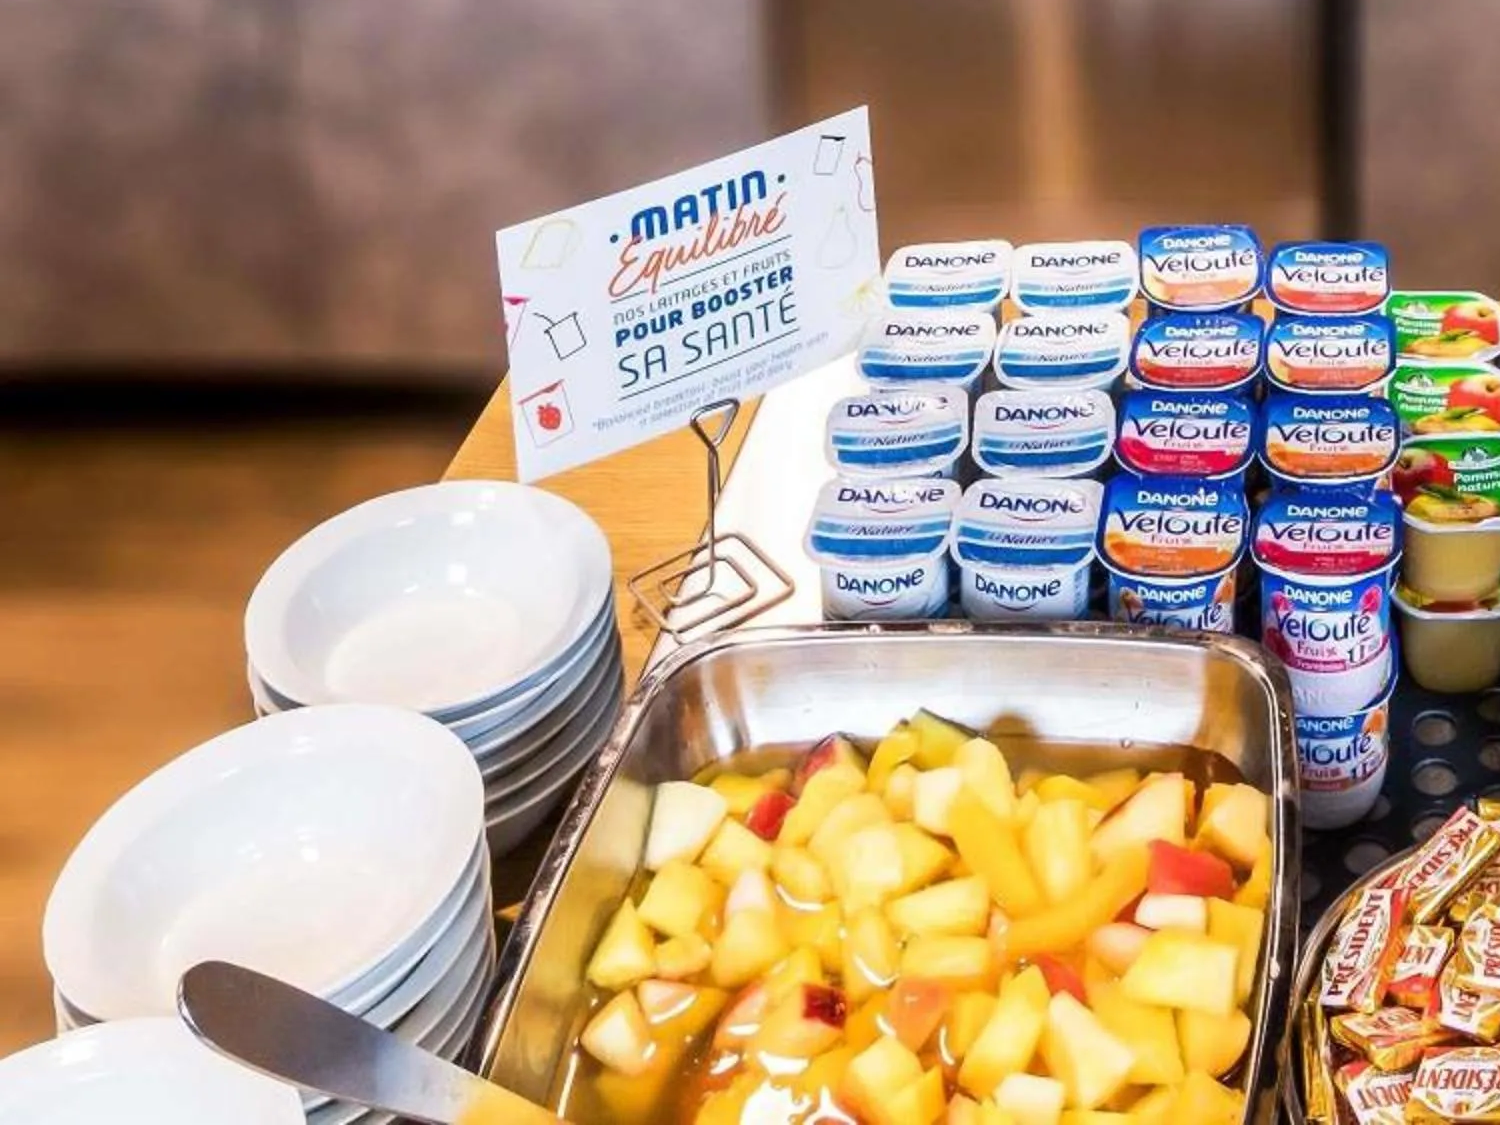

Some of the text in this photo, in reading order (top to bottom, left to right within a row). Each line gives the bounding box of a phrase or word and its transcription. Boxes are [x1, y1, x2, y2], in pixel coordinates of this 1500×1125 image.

[631, 170, 767, 241] MATIN
[1163, 234, 1231, 250] DANONE
[905, 252, 995, 269] DANONE
[1031, 252, 1121, 269] DANONE
[1147, 248, 1255, 273] Velouté
[613, 248, 792, 326] NOS LAITAGES ET FRUITS
[615, 265, 793, 348] POUR BOOSTER
[617, 285, 797, 389] SA SANTÉ
[1292, 323, 1364, 337] DANONE
[1274, 338, 1387, 359] Velouté
[995, 402, 1095, 423] DANONE
[1151, 400, 1229, 416] DANONE
[1293, 407, 1370, 421] DANONE
[1132, 418, 1249, 442] Velouté
[1273, 422, 1393, 445] Velouté
[979, 492, 1087, 513] DANONE
[1137, 489, 1219, 506] DANONE
[1118, 507, 1241, 536] Velouté
[1287, 504, 1369, 518] DANONE
[1268, 520, 1391, 543] Velouté
[837, 568, 925, 593] DANONE
[975, 573, 1061, 601] DANONE
[1284, 585, 1353, 605] DANONE
[1276, 608, 1371, 642] Velouté
[1327, 891, 1384, 996] PRÉSIDENT
